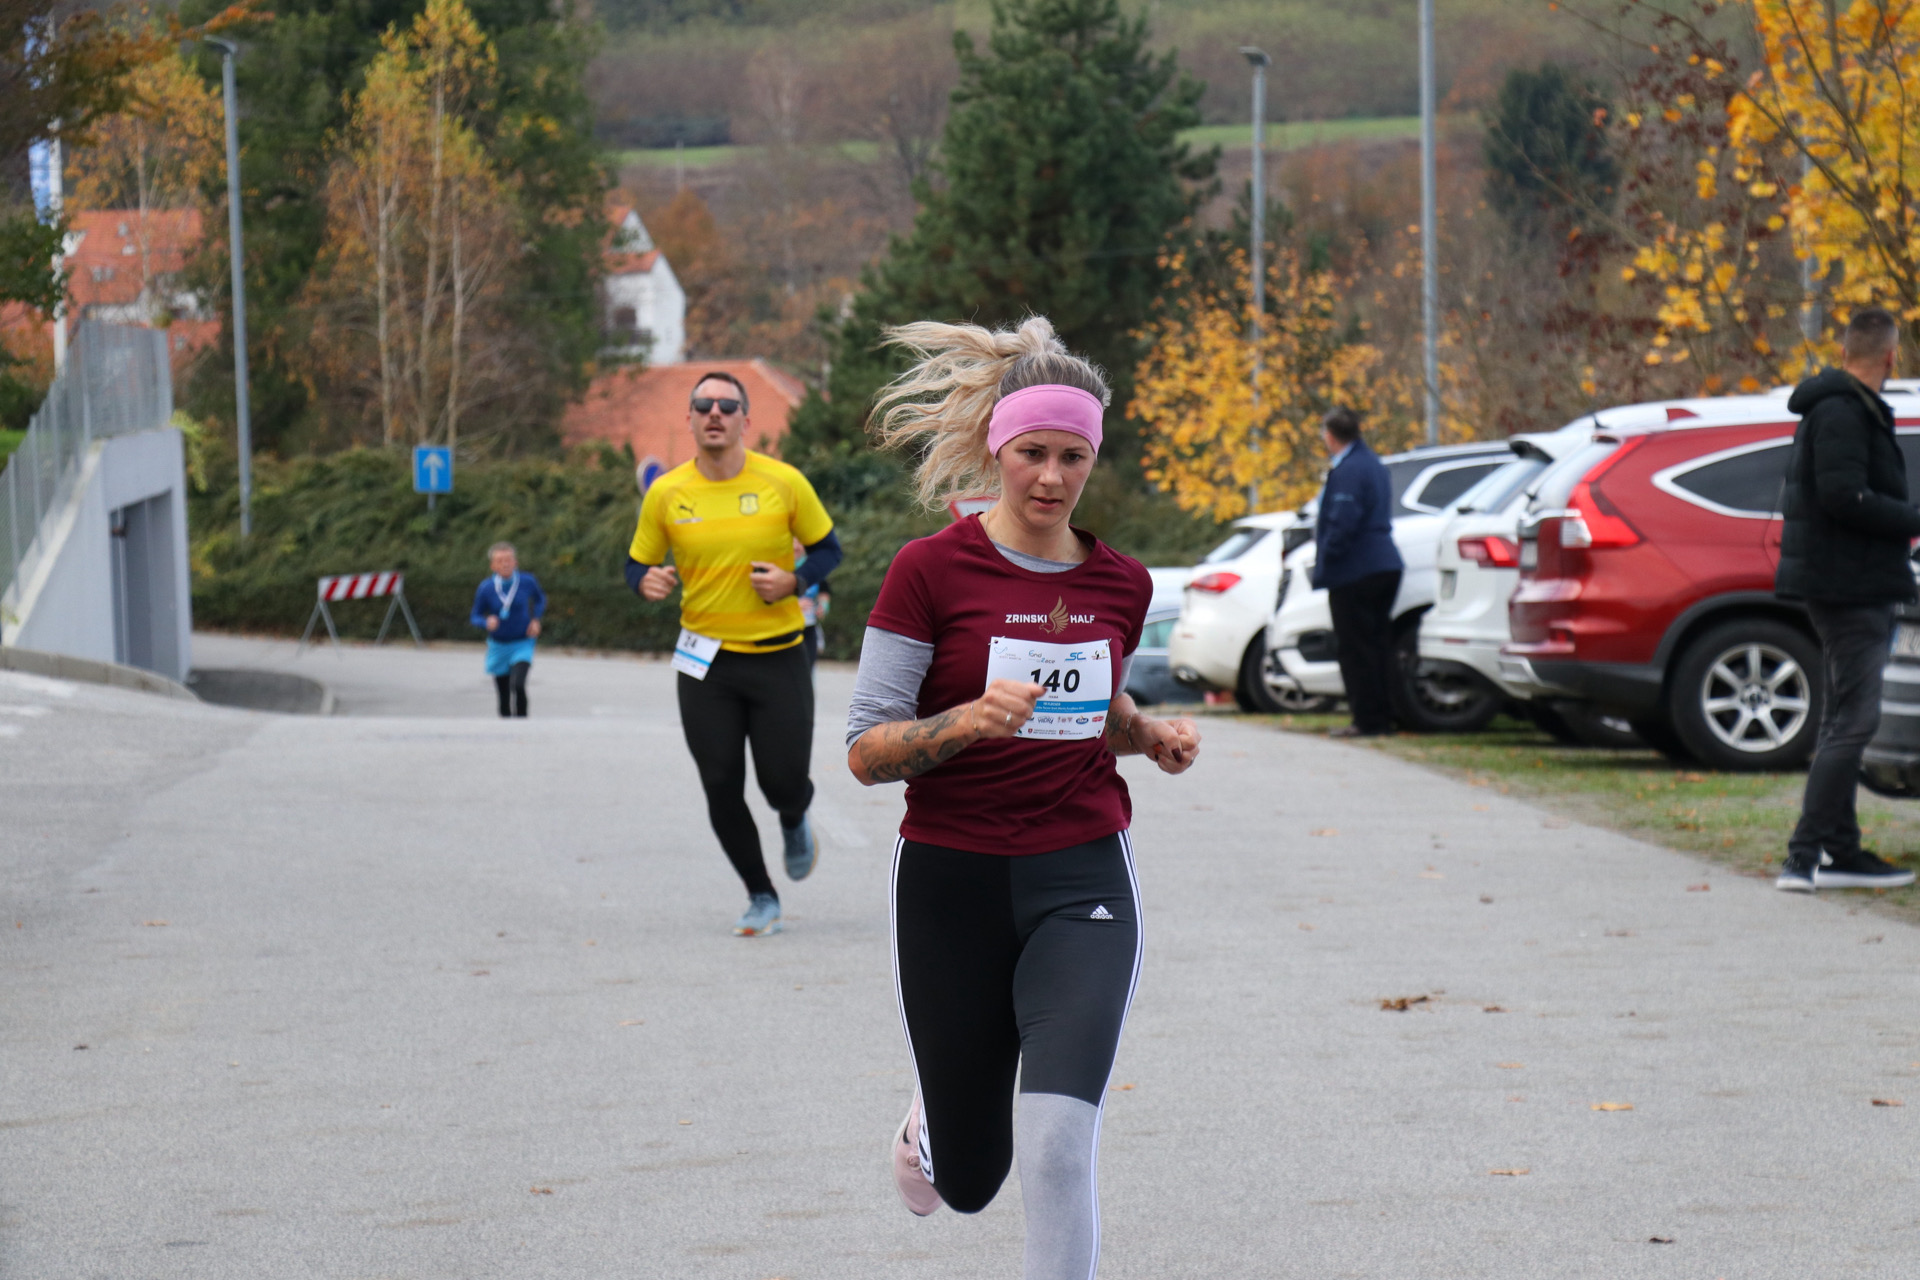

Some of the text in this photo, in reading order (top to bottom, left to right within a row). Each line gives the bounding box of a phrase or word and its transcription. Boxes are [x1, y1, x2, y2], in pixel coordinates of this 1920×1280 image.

[1005, 614, 1096, 624] ZRINSKI HALF
[1030, 668, 1080, 693] 140
